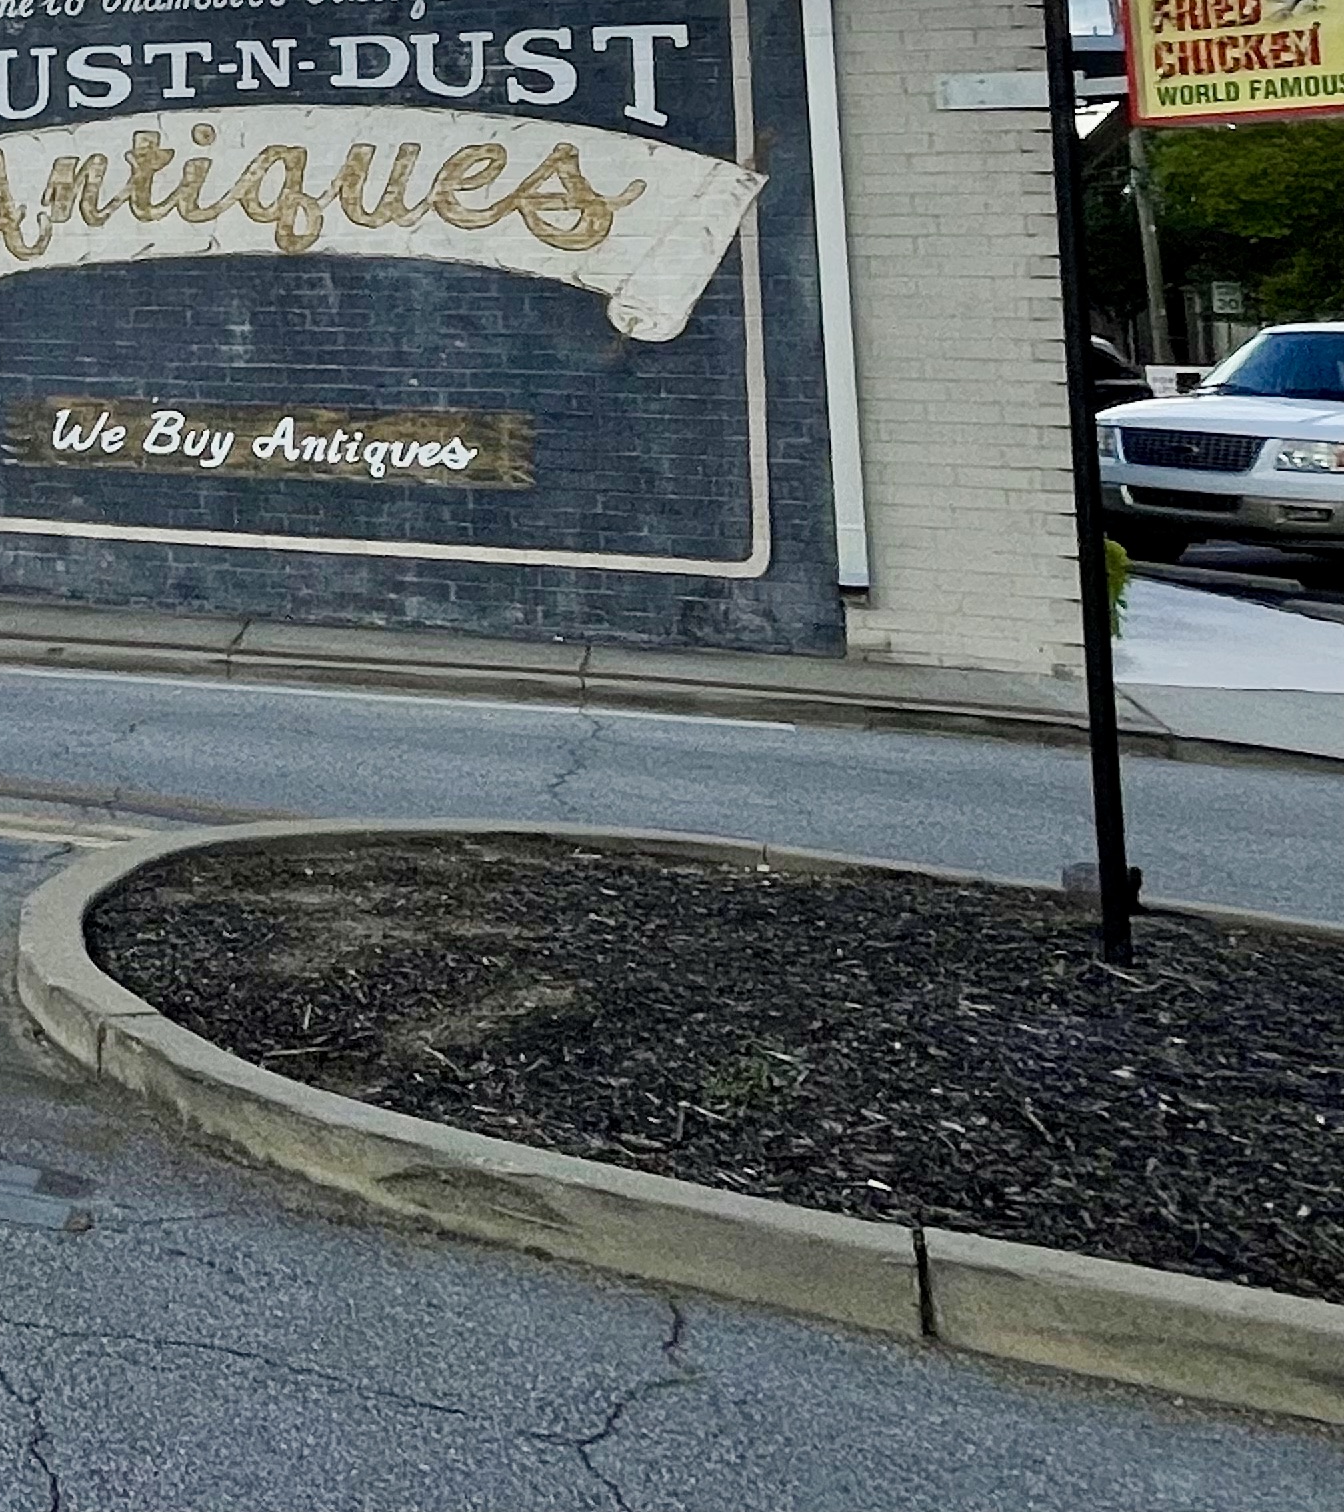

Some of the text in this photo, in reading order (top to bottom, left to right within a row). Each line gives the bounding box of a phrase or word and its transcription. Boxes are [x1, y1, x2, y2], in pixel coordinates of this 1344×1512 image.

[1154, 21, 1322, 81] CHICKEN
[1157, 80, 1240, 107] WORLD
[52, 408, 479, 479] We Buy Antiques
